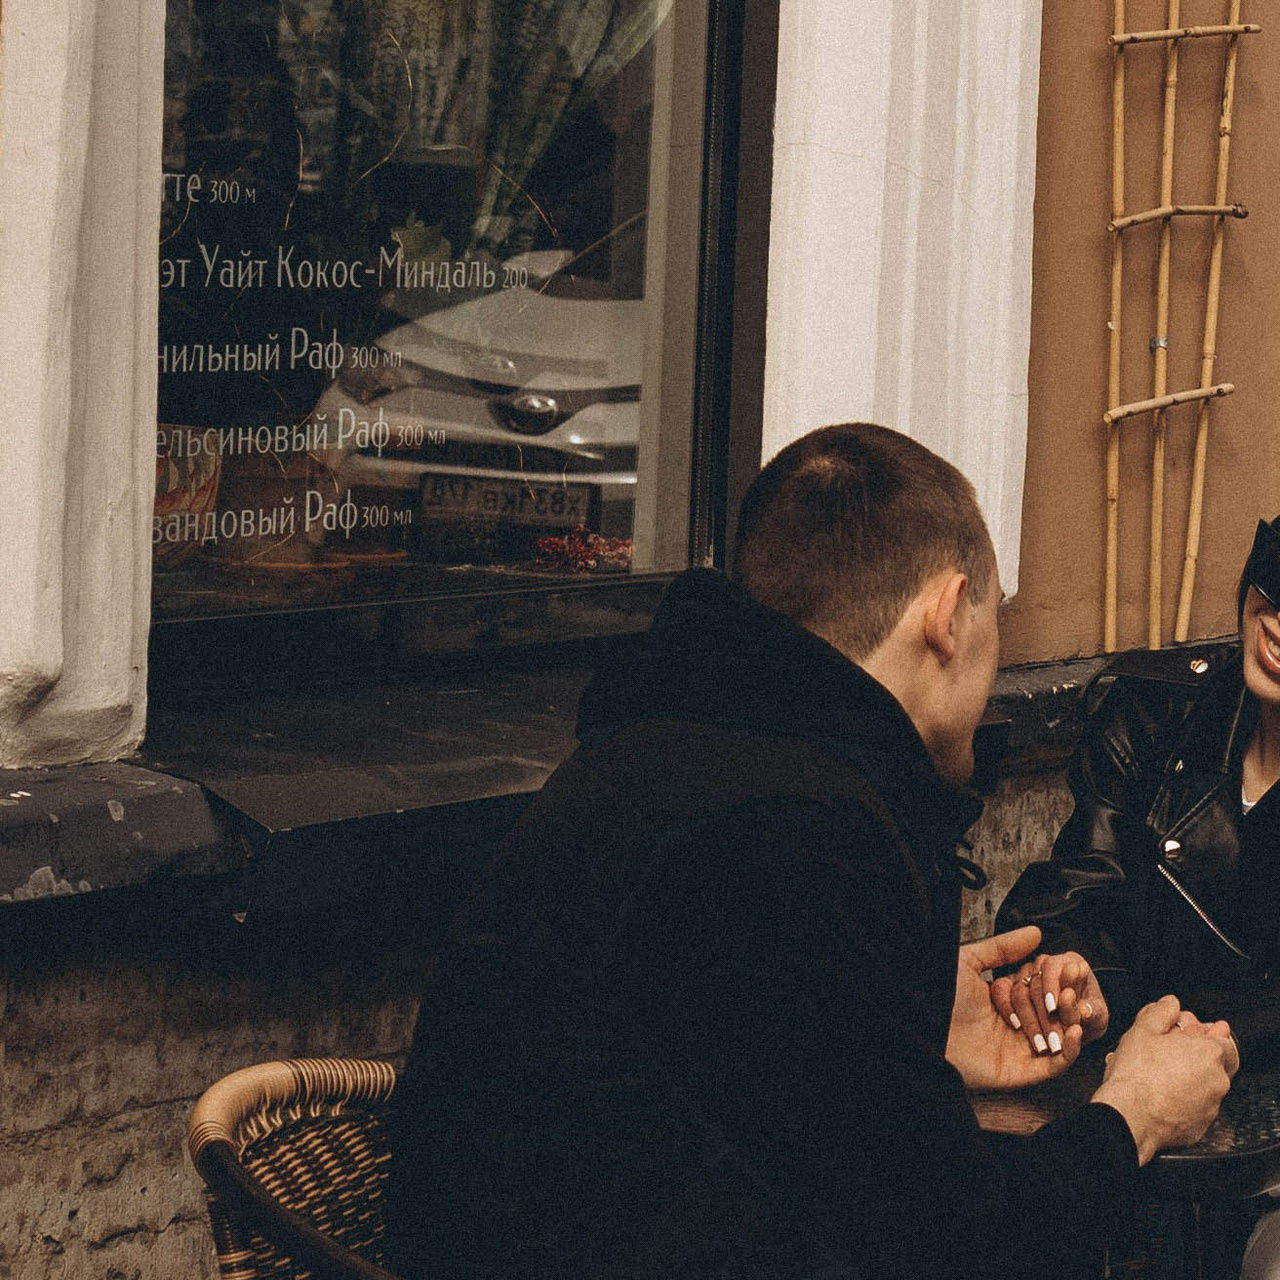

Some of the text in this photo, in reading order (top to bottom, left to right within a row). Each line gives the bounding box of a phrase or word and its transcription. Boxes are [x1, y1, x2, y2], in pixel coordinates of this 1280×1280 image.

[210, 180, 240, 204] 300
[199, 244, 268, 288] Уайт
[277, 245, 496, 293] Кокос-Миндаль
[502, 266, 529, 289] 200
[290, 327, 345, 379] Раф
[350, 346, 379, 369] 300
[383, 351, 402, 368] мл
[337, 407, 391, 457] Раф
[396, 424, 424, 448] 300
[427, 429, 446, 445] мл
[304, 489, 358, 539] Раф
[361, 505, 389, 529] 300
[393, 508, 412, 525] мл
